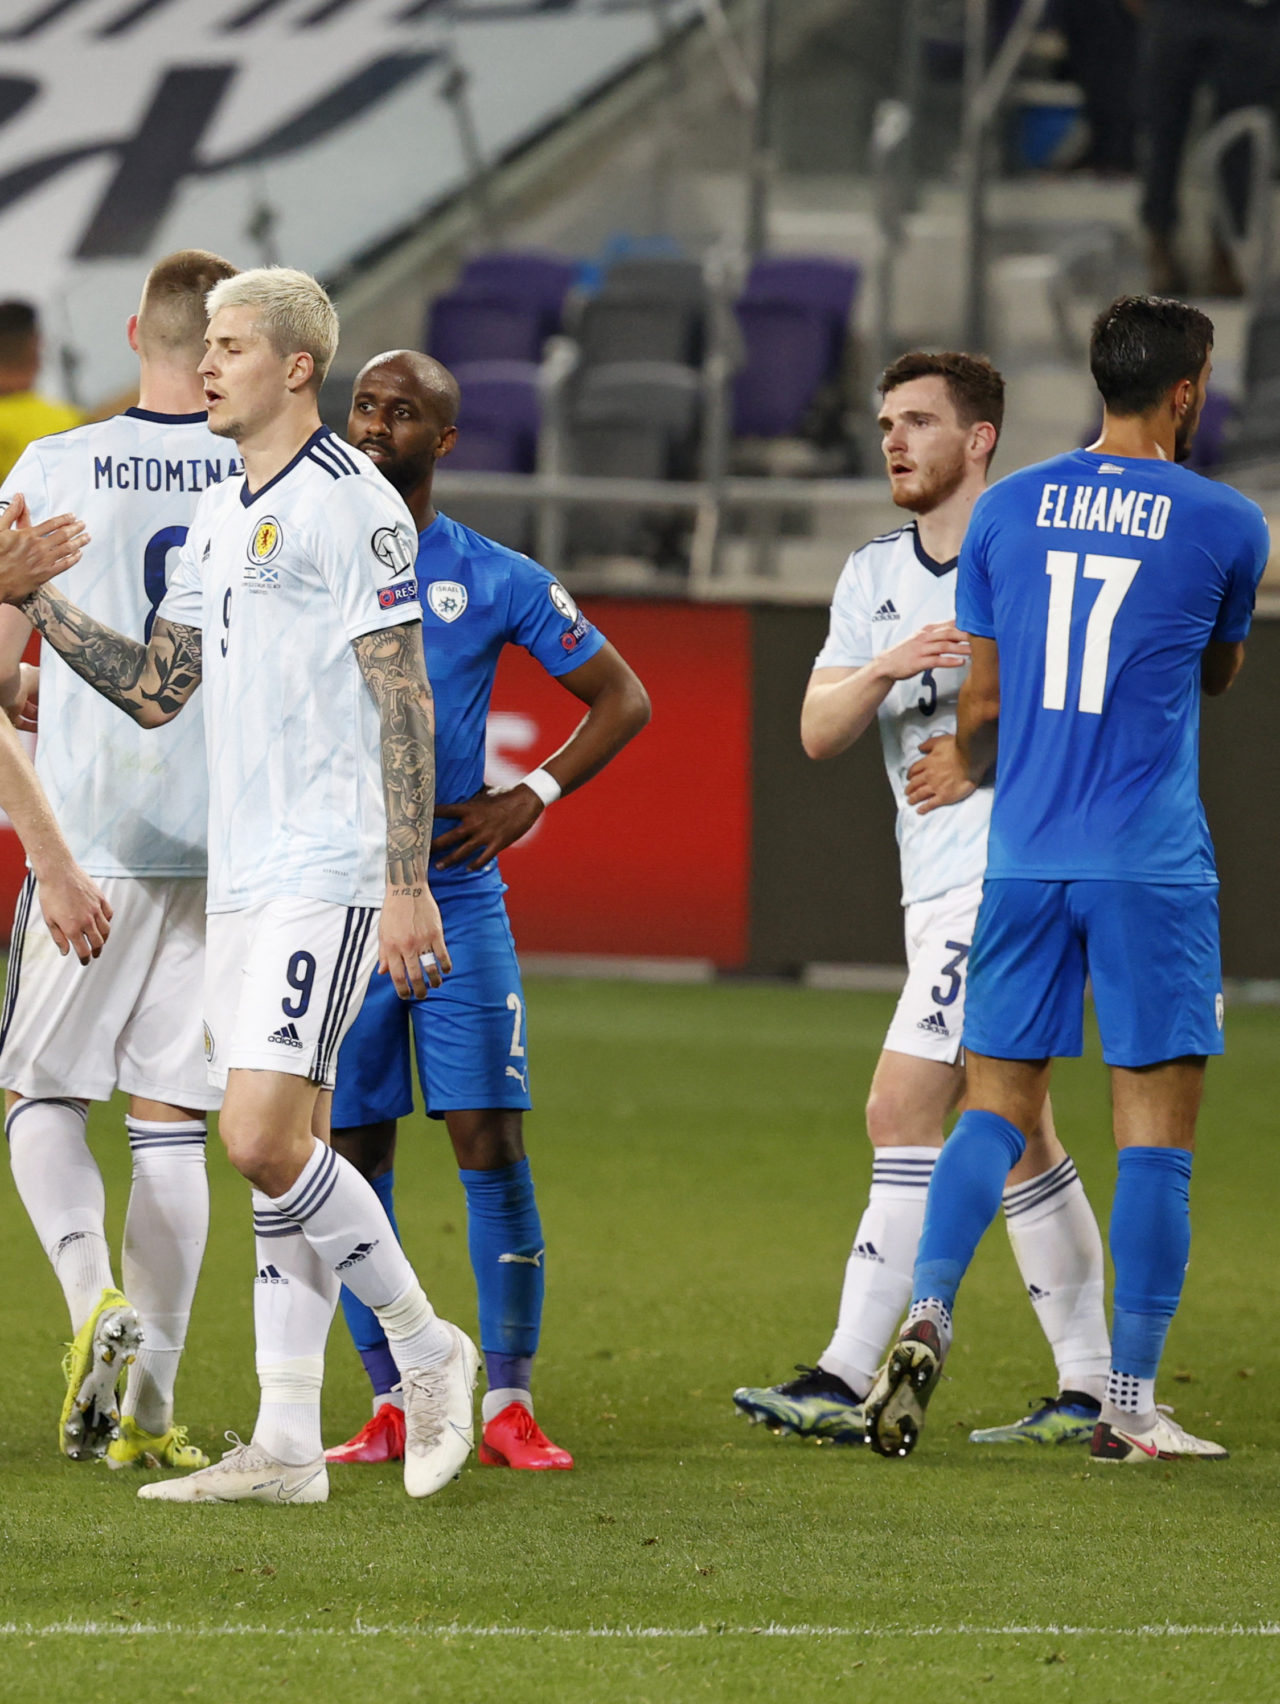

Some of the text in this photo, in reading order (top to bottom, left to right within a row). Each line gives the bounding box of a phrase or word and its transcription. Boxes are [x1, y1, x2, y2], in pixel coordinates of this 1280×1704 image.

[1036, 483, 1172, 541] ELHAMED
[221, 585, 232, 658] 9
[1043, 550, 1142, 715] 17
[918, 668, 937, 717] 3
[282, 950, 316, 1018] 9
[931, 940, 970, 1006] 3
[268, 1034, 303, 1049] adidas
[506, 993, 525, 1056] 2
[917, 1022, 950, 1036] adidas
